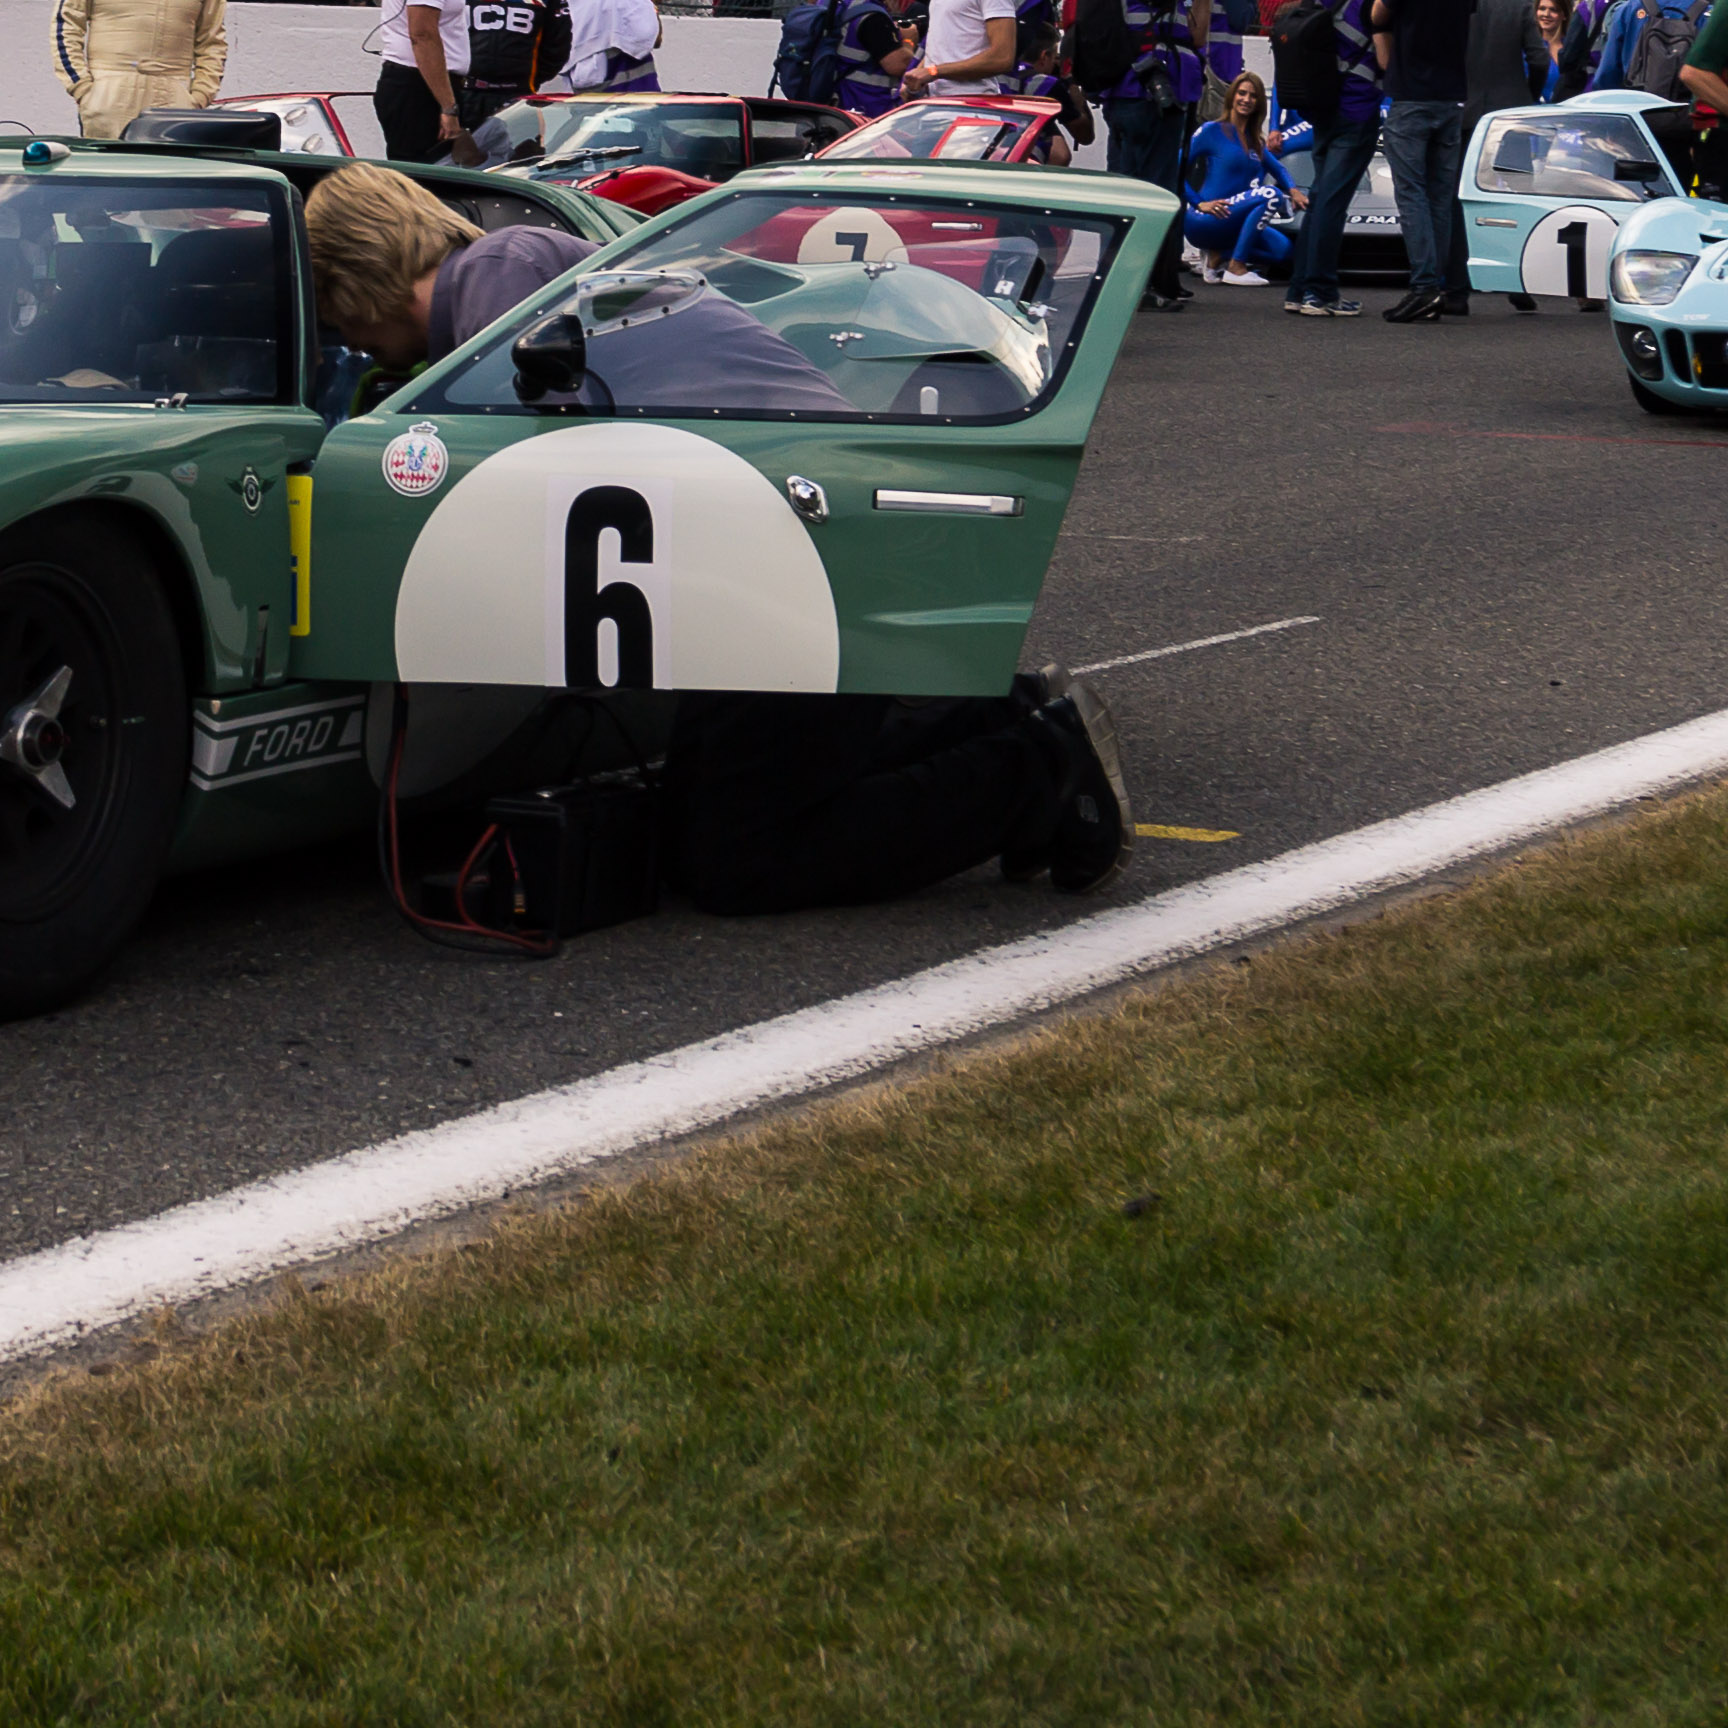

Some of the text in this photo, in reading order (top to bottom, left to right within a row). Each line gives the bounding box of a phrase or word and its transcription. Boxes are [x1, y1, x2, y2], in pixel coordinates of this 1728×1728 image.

[835, 232, 869, 263] 7
[1557, 221, 1588, 298] 1
[564, 485, 654, 689] 6
[243, 716, 335, 767] FORD
